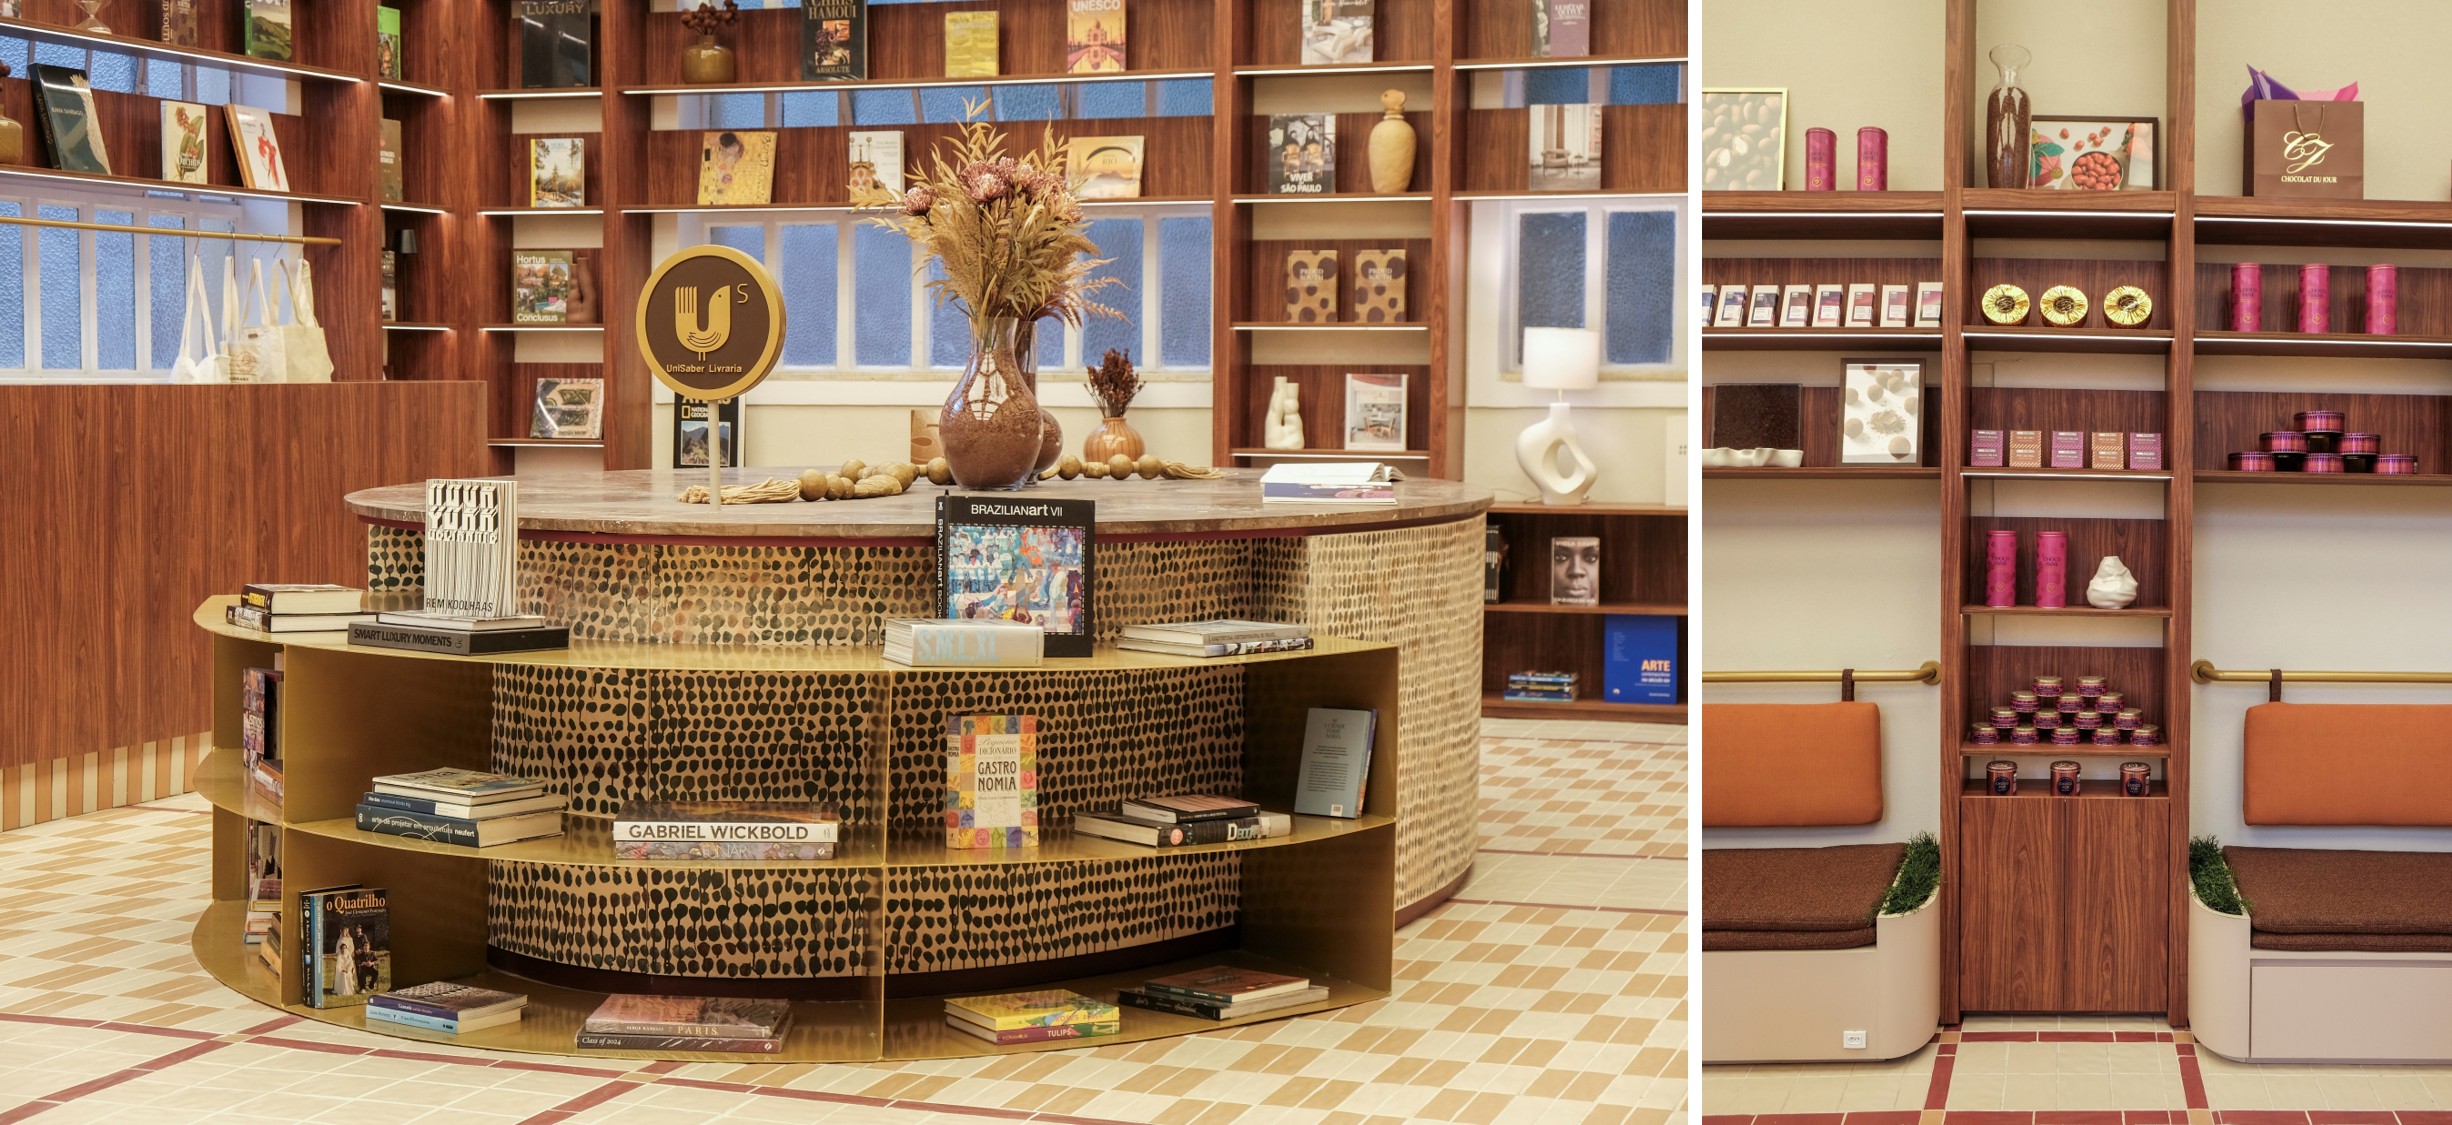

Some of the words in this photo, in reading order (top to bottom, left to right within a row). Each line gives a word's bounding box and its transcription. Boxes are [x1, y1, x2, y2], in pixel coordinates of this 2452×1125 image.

[526, 4, 584, 15] LUXURY
[1072, 0, 1121, 11] UNESCO
[808, 5, 857, 19] HAMOUI
[815, 66, 851, 74] ABSOLUTE
[1289, 173, 1313, 182] VIVER
[2281, 175, 2312, 183] CHOCOLAT
[2322, 176, 2338, 184] JOUR
[1281, 183, 1297, 193] SÃO
[1297, 184, 1322, 193] PAULO
[516, 255, 546, 264] Hortus
[516, 313, 559, 322] Conclusus
[666, 364, 705, 373] UniSaber
[709, 364, 743, 373] Livraria
[971, 504, 1048, 516] BRAZILIANart
[1050, 507, 1063, 517] VII
[426, 598, 445, 609] REM
[447, 599, 493, 612] KOOLHAAS
[353, 628, 379, 641] SMART
[380, 630, 411, 645] LUXURY
[412, 632, 451, 648] MOMENTS
[1641, 660, 1671, 672] ARTE
[978, 761, 1017, 775] GASTRO
[977, 777, 1017, 792] NOMIA
[371, 816, 383, 824] arte
[391, 818, 413, 829] projetar
[423, 823, 453, 834] arquitetura
[454, 828, 475, 838] neufert
[629, 824, 706, 839] GABRIEL
[710, 825, 808, 840] WICKBOLD
[326, 901, 333, 911] o
[335, 893, 386, 914] Quatrilho
[677, 1025, 718, 1036] PARIS
[1047, 1029, 1072, 1038] TULIPS
[582, 1035, 598, 1045] Class
[599, 1036, 606, 1047] of
